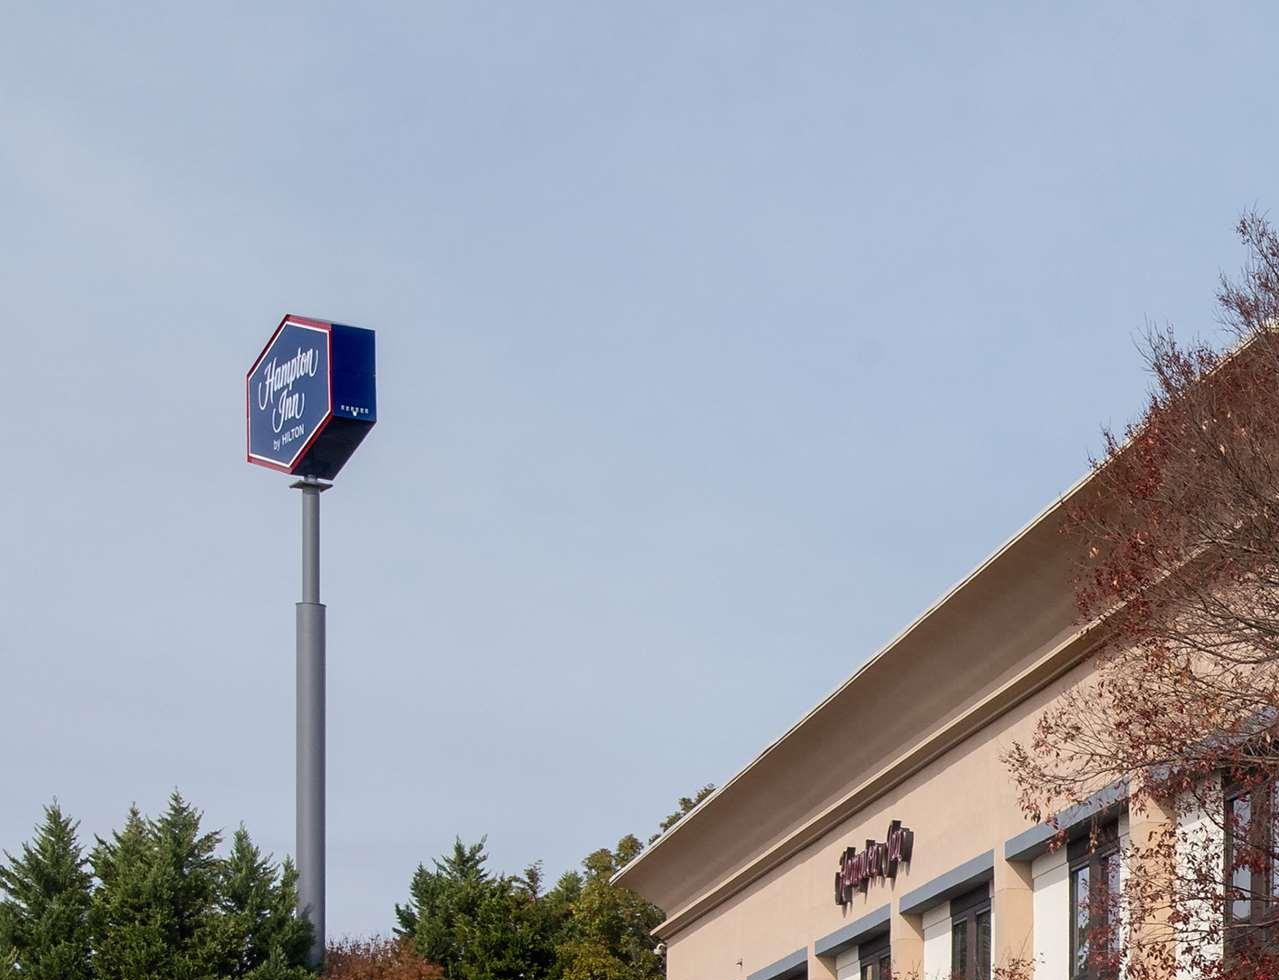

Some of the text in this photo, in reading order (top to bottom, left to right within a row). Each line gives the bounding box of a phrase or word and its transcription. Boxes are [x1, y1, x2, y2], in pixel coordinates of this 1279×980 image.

[258, 347, 319, 411] Hampton
[272, 388, 305, 433] Inn
[273, 424, 305, 451] by HILTON
